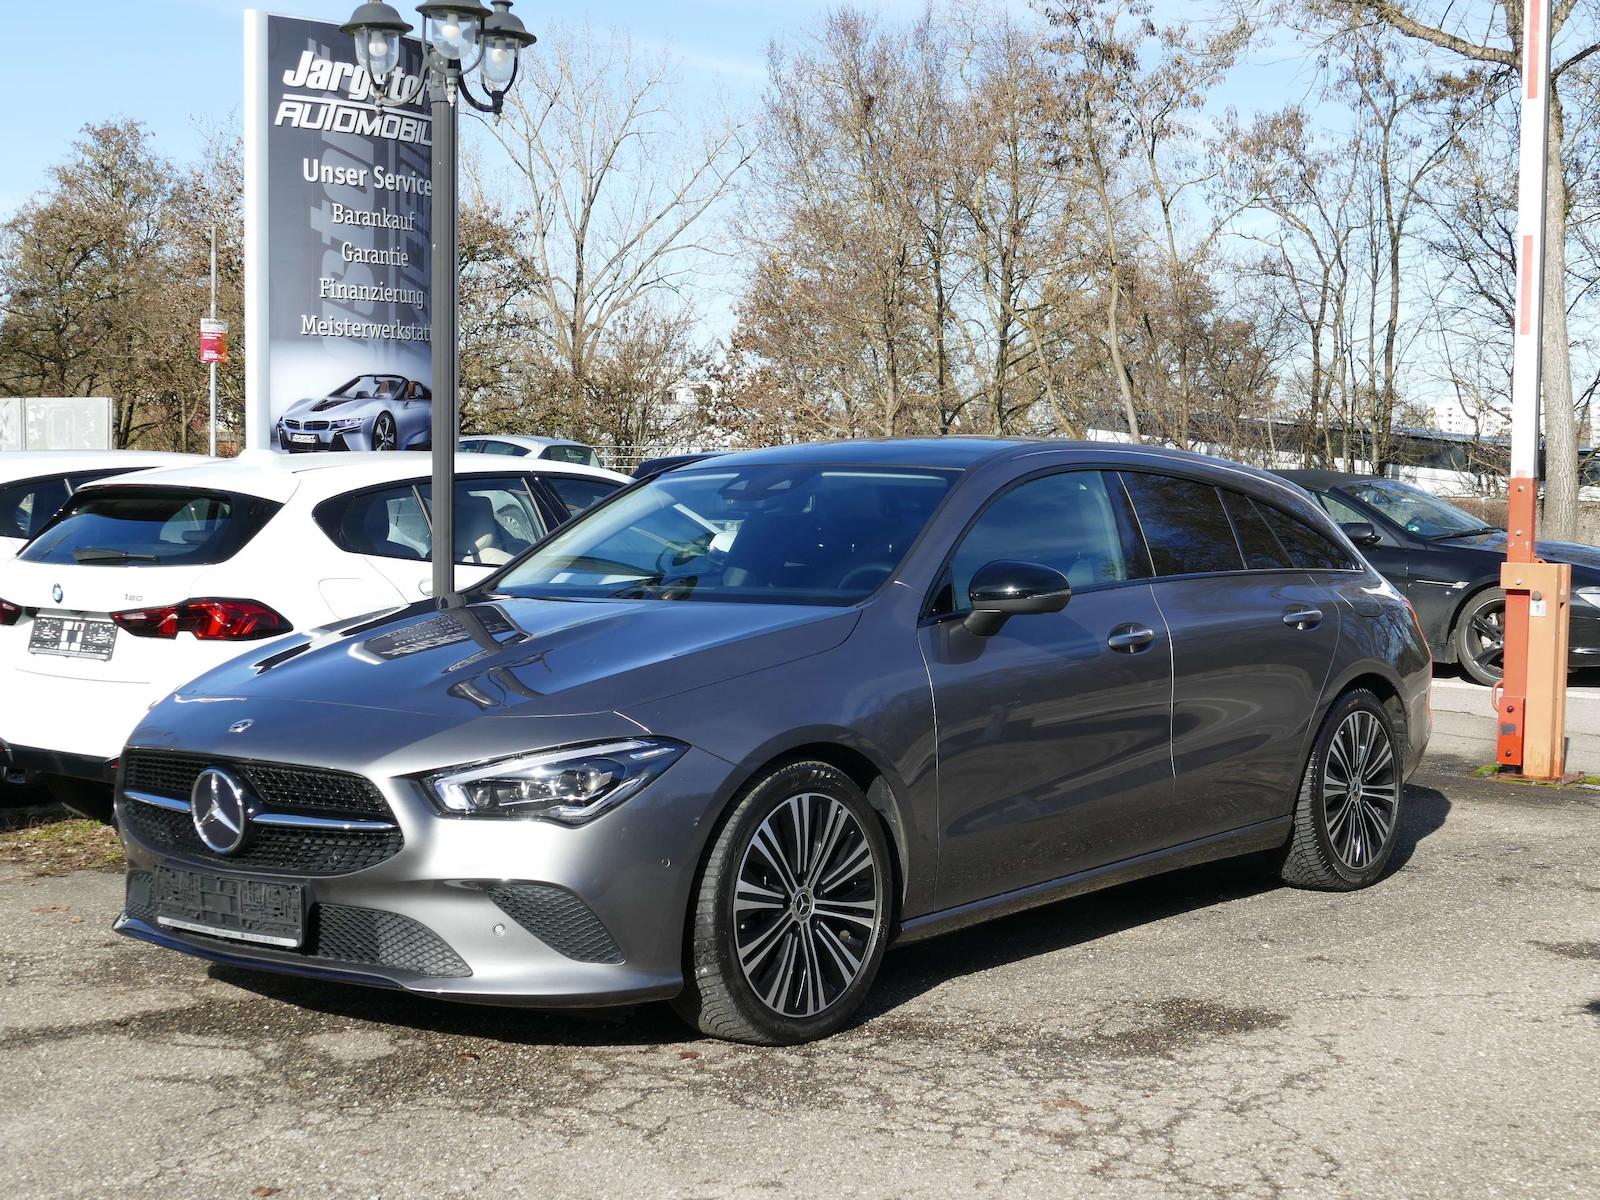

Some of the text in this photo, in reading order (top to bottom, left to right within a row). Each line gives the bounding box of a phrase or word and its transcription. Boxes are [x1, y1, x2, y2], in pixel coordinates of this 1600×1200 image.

[303, 158, 432, 197] Unser Service
[332, 203, 415, 231] Barankauf
[341, 241, 410, 267] Garantie
[319, 277, 425, 309] Finanzierung
